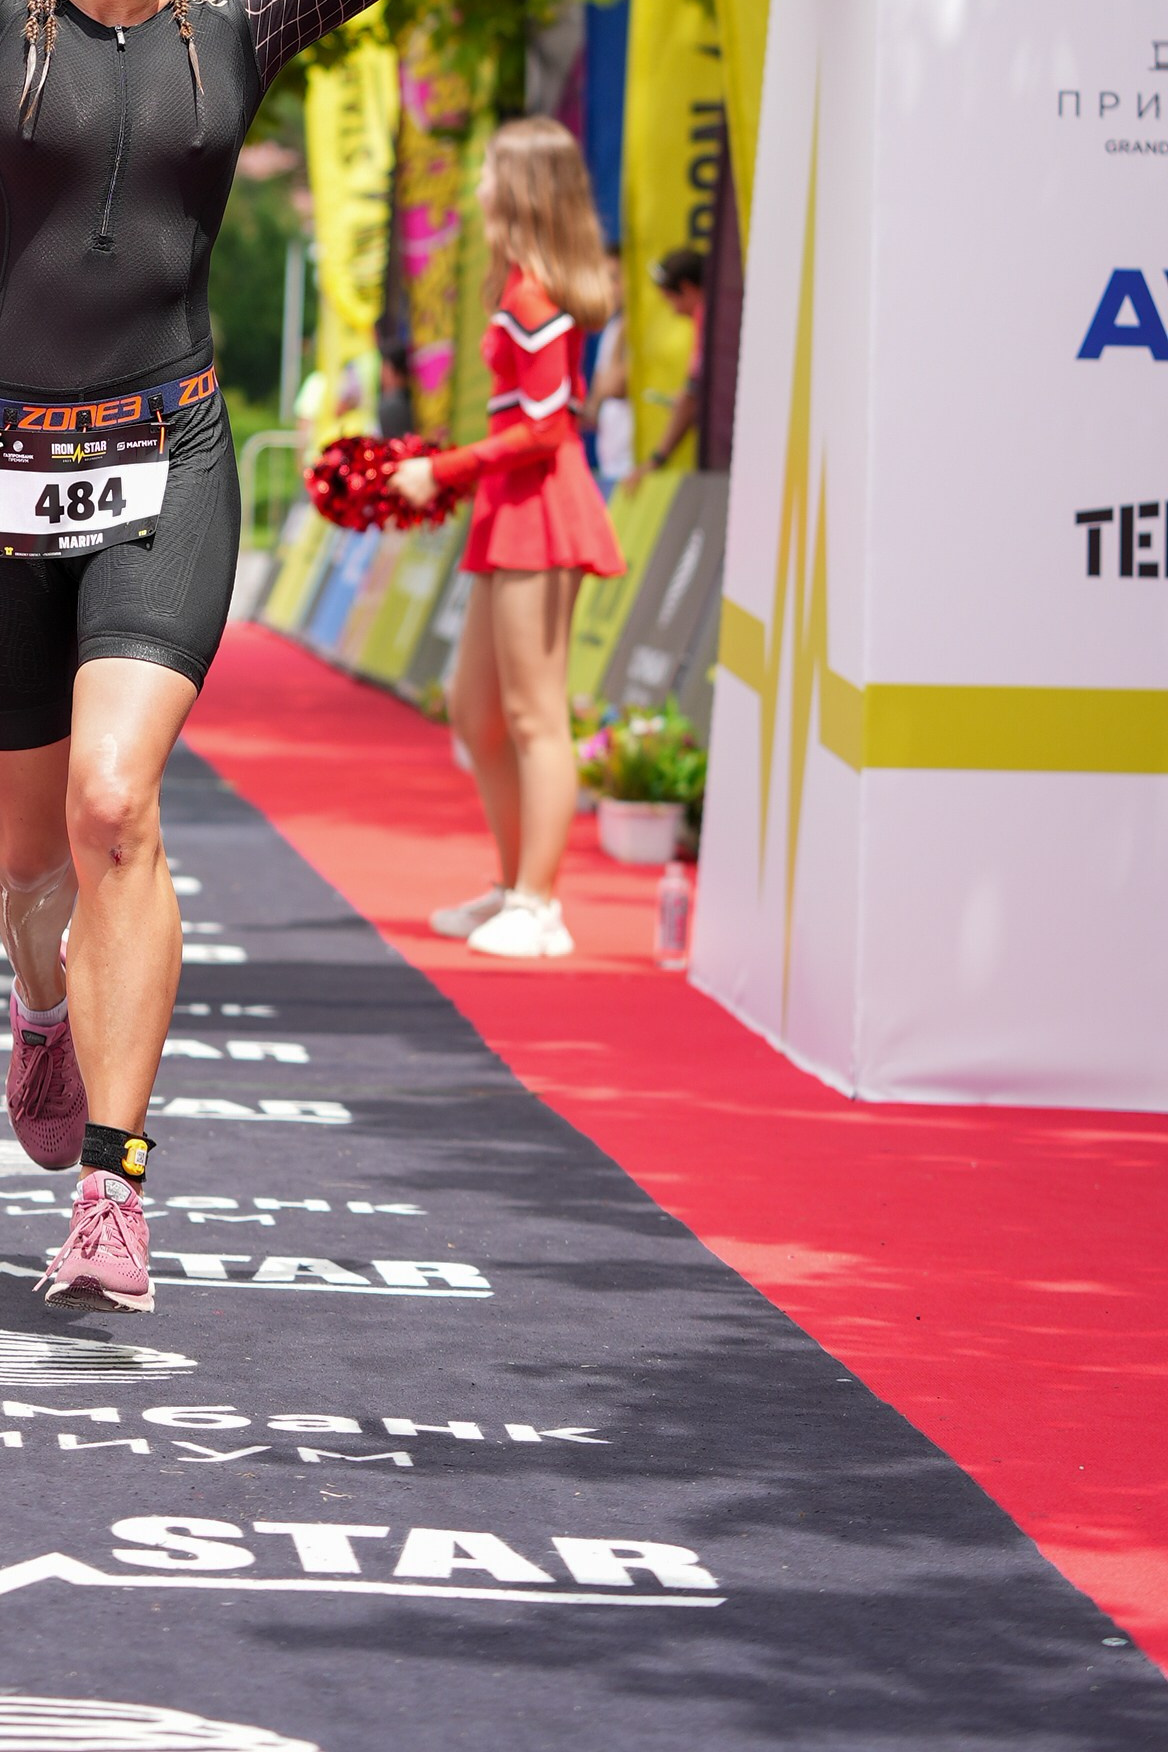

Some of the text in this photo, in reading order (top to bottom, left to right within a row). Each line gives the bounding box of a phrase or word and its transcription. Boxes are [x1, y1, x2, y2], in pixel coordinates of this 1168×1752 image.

[1057, 90, 1160, 119] ПРИ
[178, 365, 219, 406] ZO
[51, 440, 107, 455] IRON STAR
[126, 439, 158, 449] МАГНИТ
[34, 476, 127, 525] 484
[58, 532, 104, 550] MARIYA
[1075, 501, 1168, 579] TE
[110, 1515, 721, 1590] STAR
